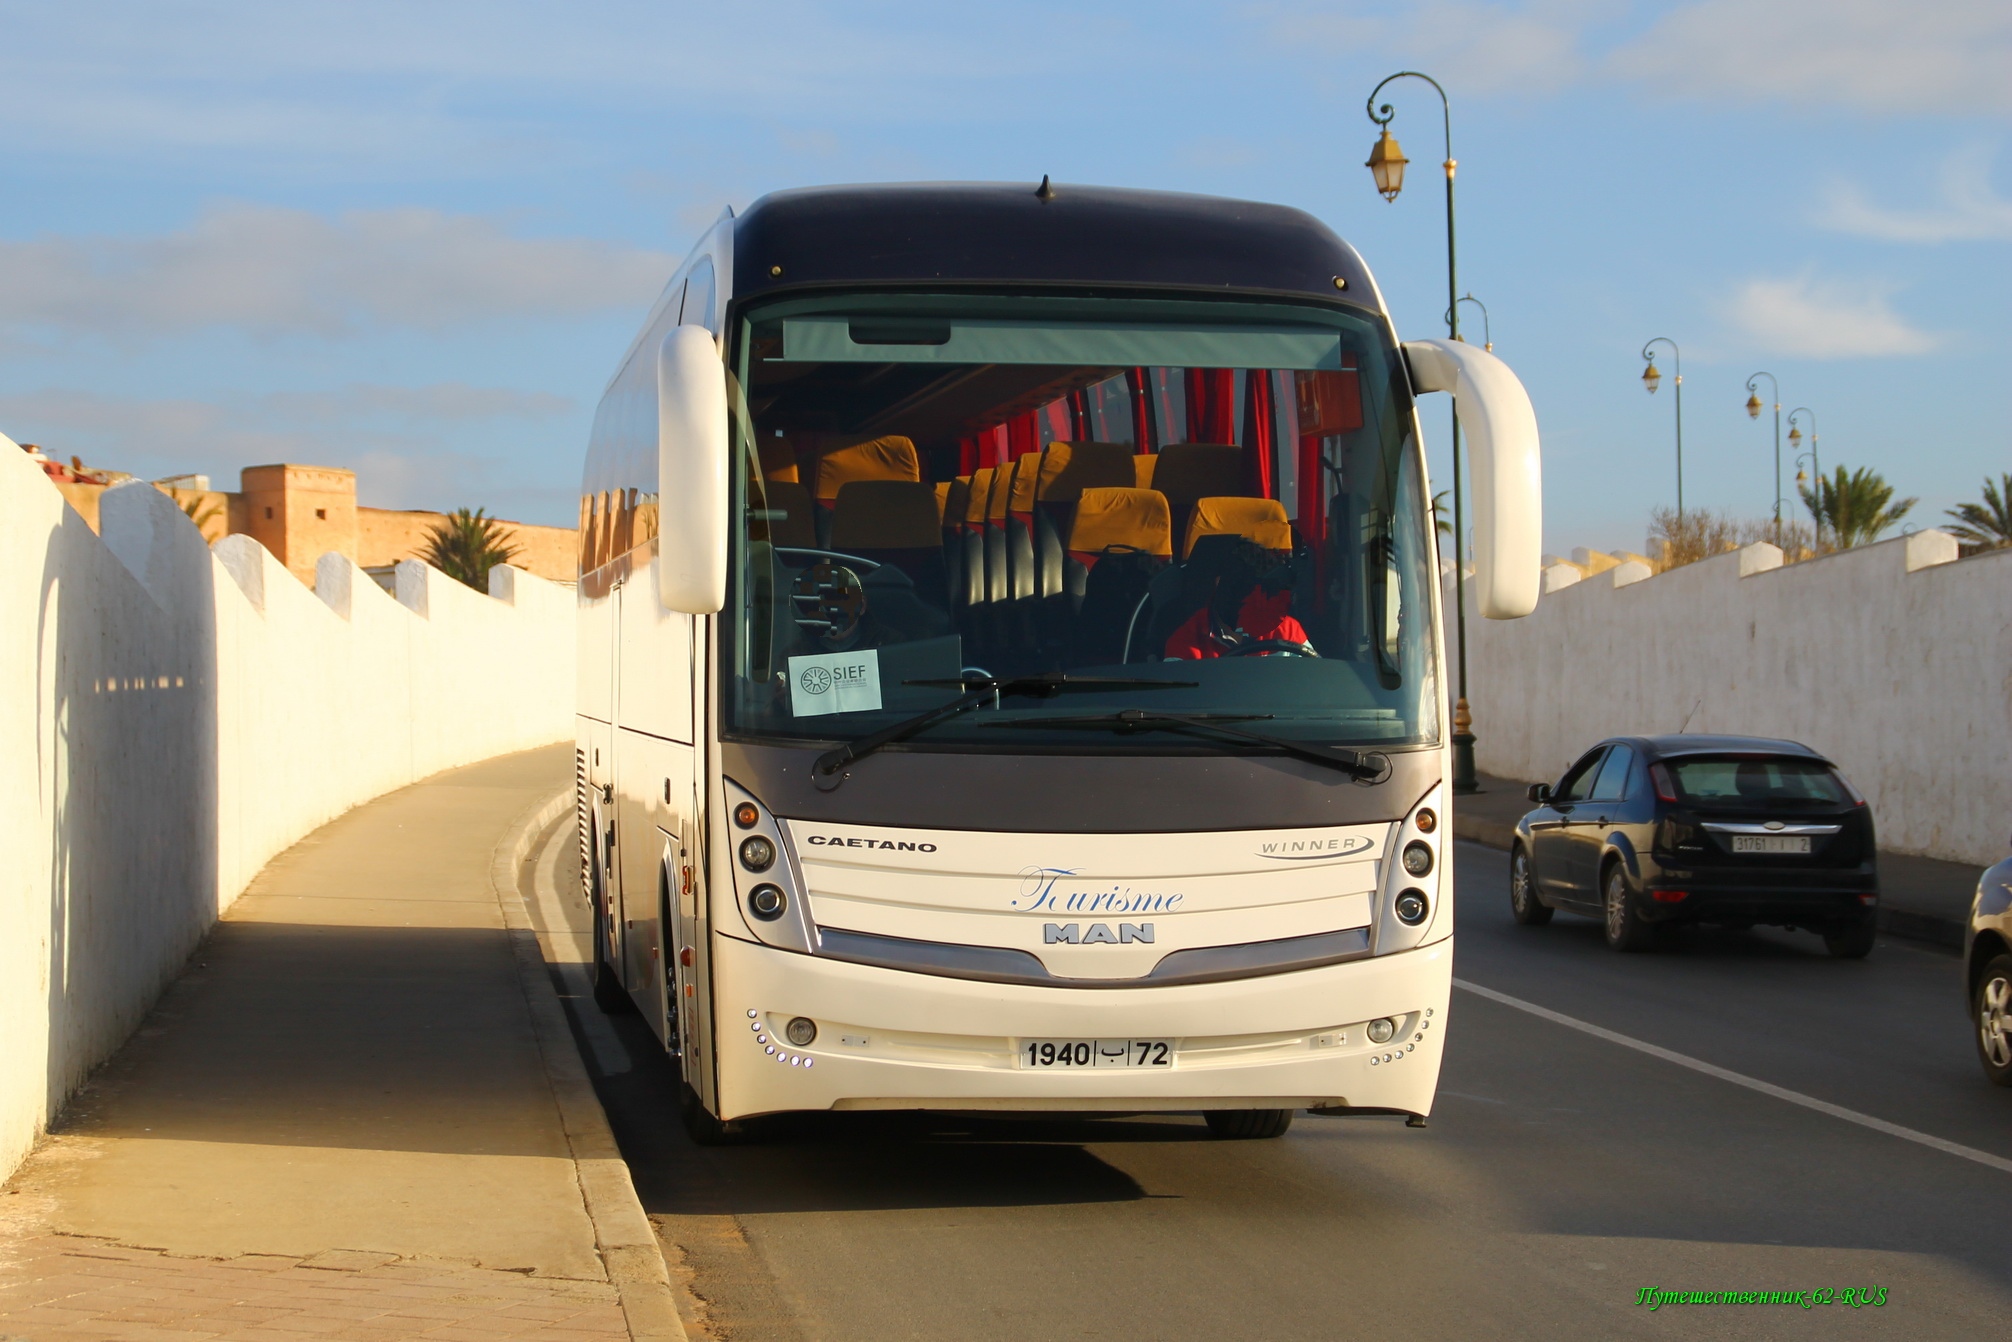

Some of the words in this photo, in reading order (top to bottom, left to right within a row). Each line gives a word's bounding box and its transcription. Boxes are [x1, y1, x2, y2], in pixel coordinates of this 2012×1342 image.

[833, 665, 866, 681] SIEF
[807, 835, 938, 854] CAETANO
[1261, 838, 1358, 855] WINNER
[1043, 923, 1155, 945] MAN
[1028, 1042, 1090, 1066] 1940
[1101, 1047, 1125, 1063] ب
[1136, 1042, 1169, 1066] 72
